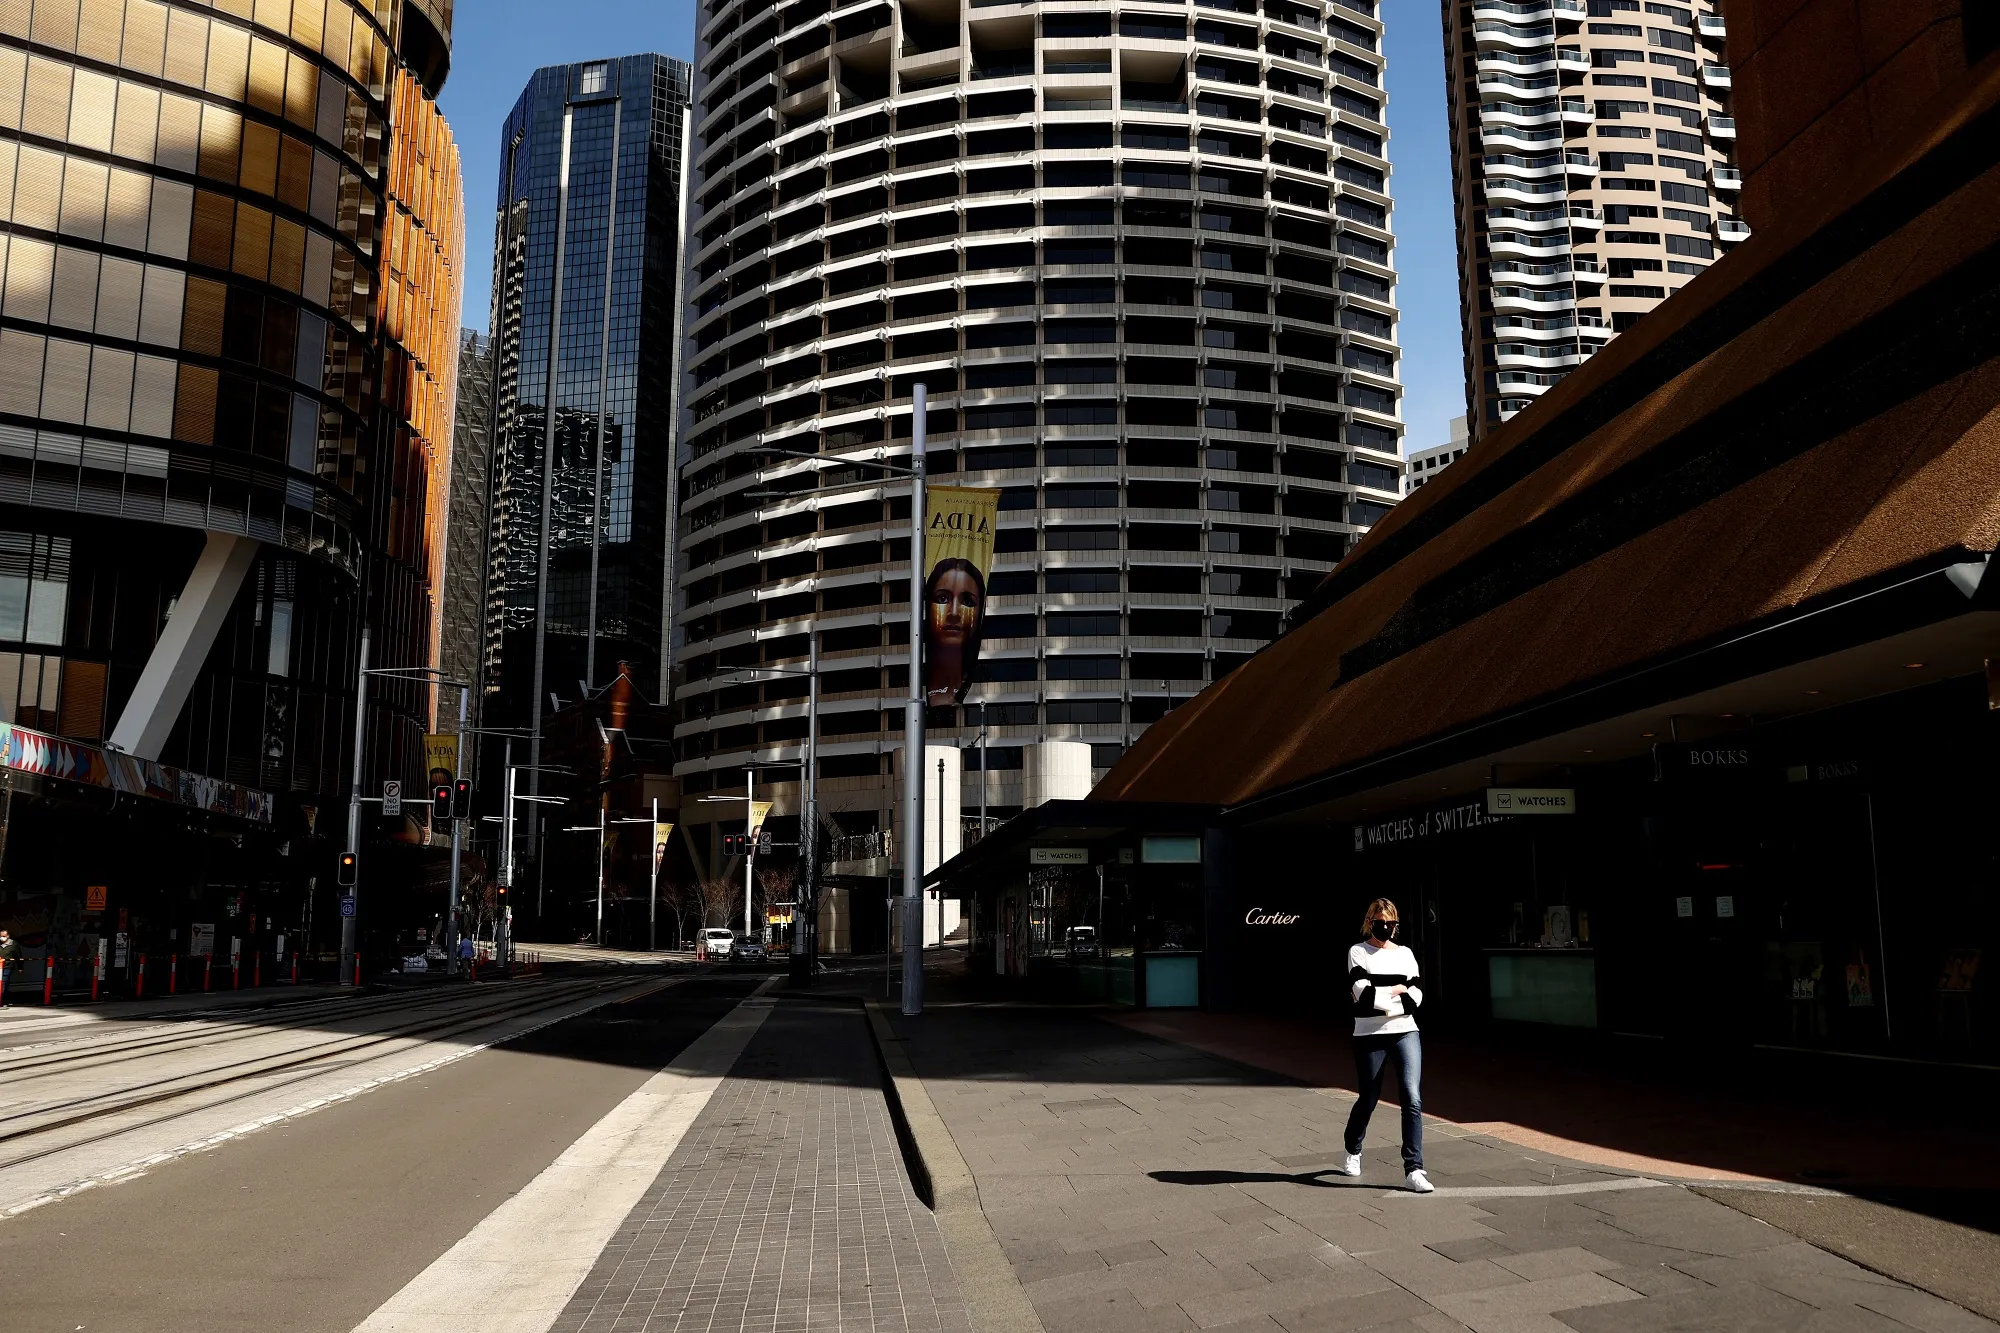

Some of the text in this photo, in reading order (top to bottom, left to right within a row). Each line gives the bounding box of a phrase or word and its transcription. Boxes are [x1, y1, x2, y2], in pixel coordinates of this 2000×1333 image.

[1689, 749, 1749, 765] BOKKS
[386, 797, 397, 805] NO
[1517, 796, 1567, 806] WATCHES
[1367, 817, 1415, 845] WATCHES
[1419, 812, 1430, 836] of
[1245, 907, 1301, 925] Cartier
